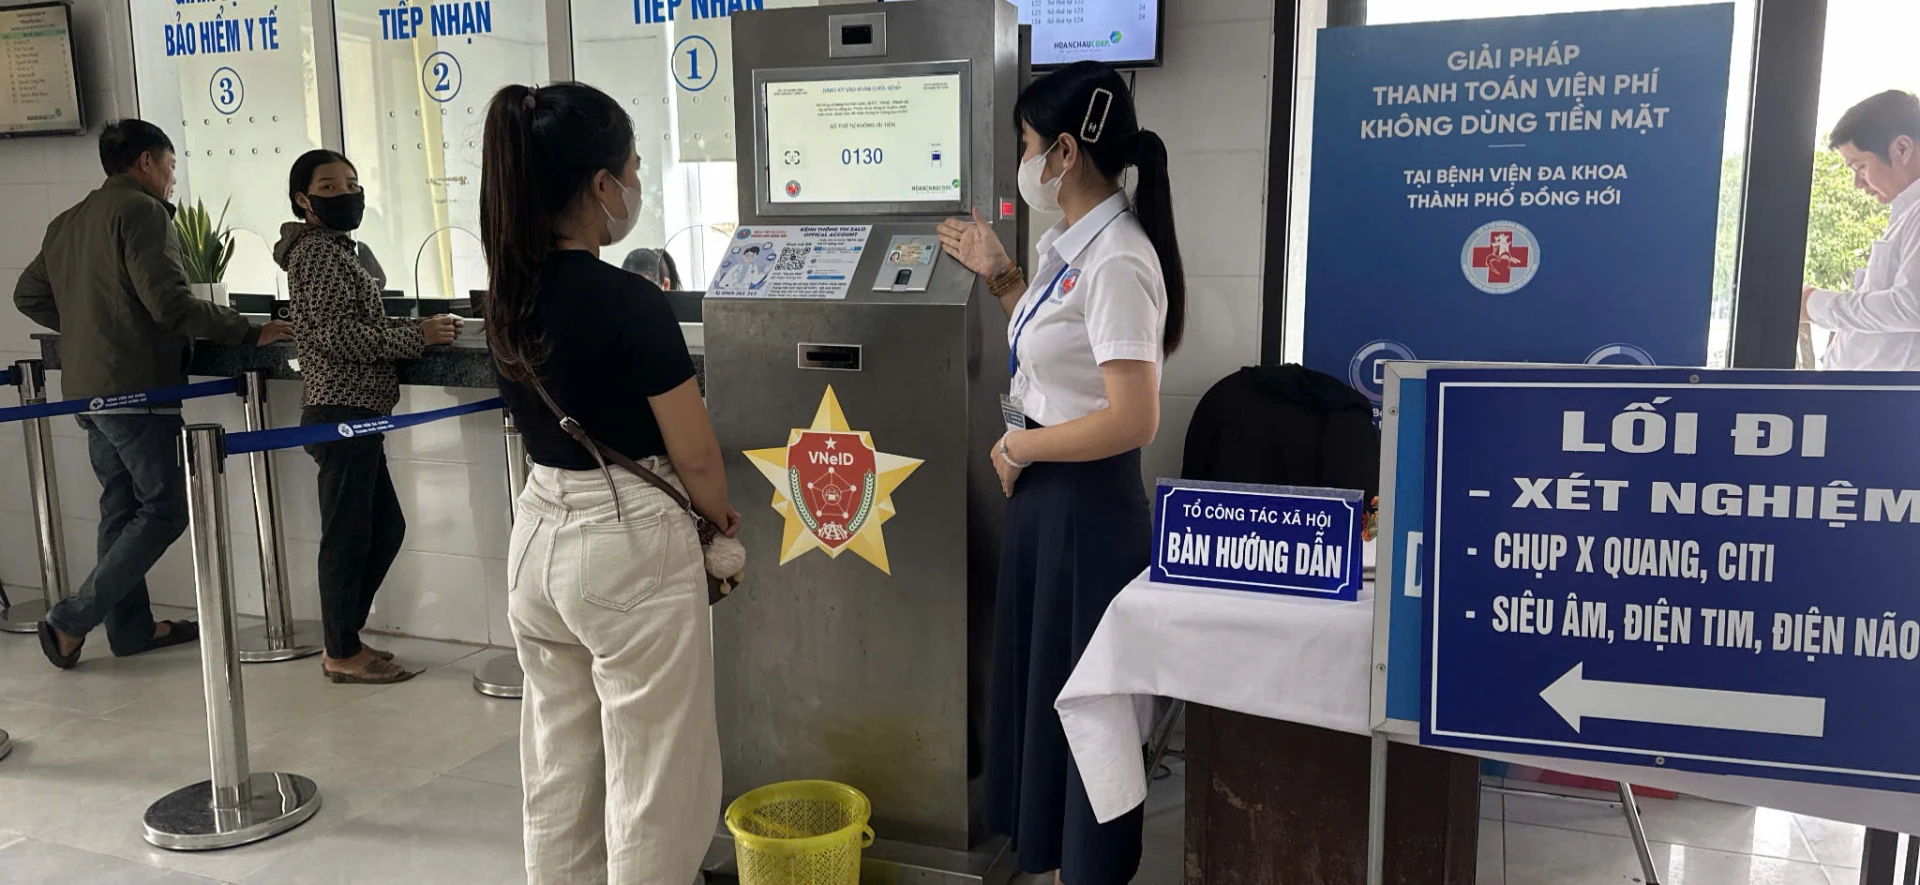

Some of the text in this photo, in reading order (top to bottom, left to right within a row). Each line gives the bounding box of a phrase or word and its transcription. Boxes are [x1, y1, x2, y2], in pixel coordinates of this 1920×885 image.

[164, 5, 279, 56] BẢO HIỂM Y TẾ
[686, 48, 702, 80] 1
[1447, 40, 1580, 72] GIẢI PHÁP
[219, 77, 235, 105] 3
[433, 62, 450, 91] 2
[1373, 67, 1660, 106] THANH TOÁN VIỆN PHÍ
[1360, 98, 1670, 140] KHÔNG DÙNG TIỀN MẶT
[841, 148, 883, 165] 0130
[1404, 162, 1628, 189] TẠI BỆNH VIỆN ĐA KHOA
[1407, 184, 1621, 208] THÀNH PHỐ ĐỒNG HỚI
[1562, 395, 1827, 458] LỐI ĐI
[808, 451, 854, 466] VNeID
[1183, 498, 1332, 531] TỔ CÔNG TÁC XÃ HỘI
[1511, 471, 1629, 512] XÉT
[1650, 479, 1920, 528] NGHIỆM
[1166, 526, 1343, 579] BÀN HƯỚNG DẪN
[1493, 531, 1568, 580] CHỤP
[1575, 535, 1596, 574] X
[1603, 536, 1708, 584] QUANG,
[1717, 542, 1776, 583] CITI
[1492, 589, 1554, 636] SIÊU
[1561, 592, 1614, 645] ÂM,
[1624, 597, 1692, 652] ĐIỆN
[1701, 607, 1763, 655] TIM,
[1772, 606, 1846, 663] ĐIỆN
[1854, 610, 1920, 661] NÃO
